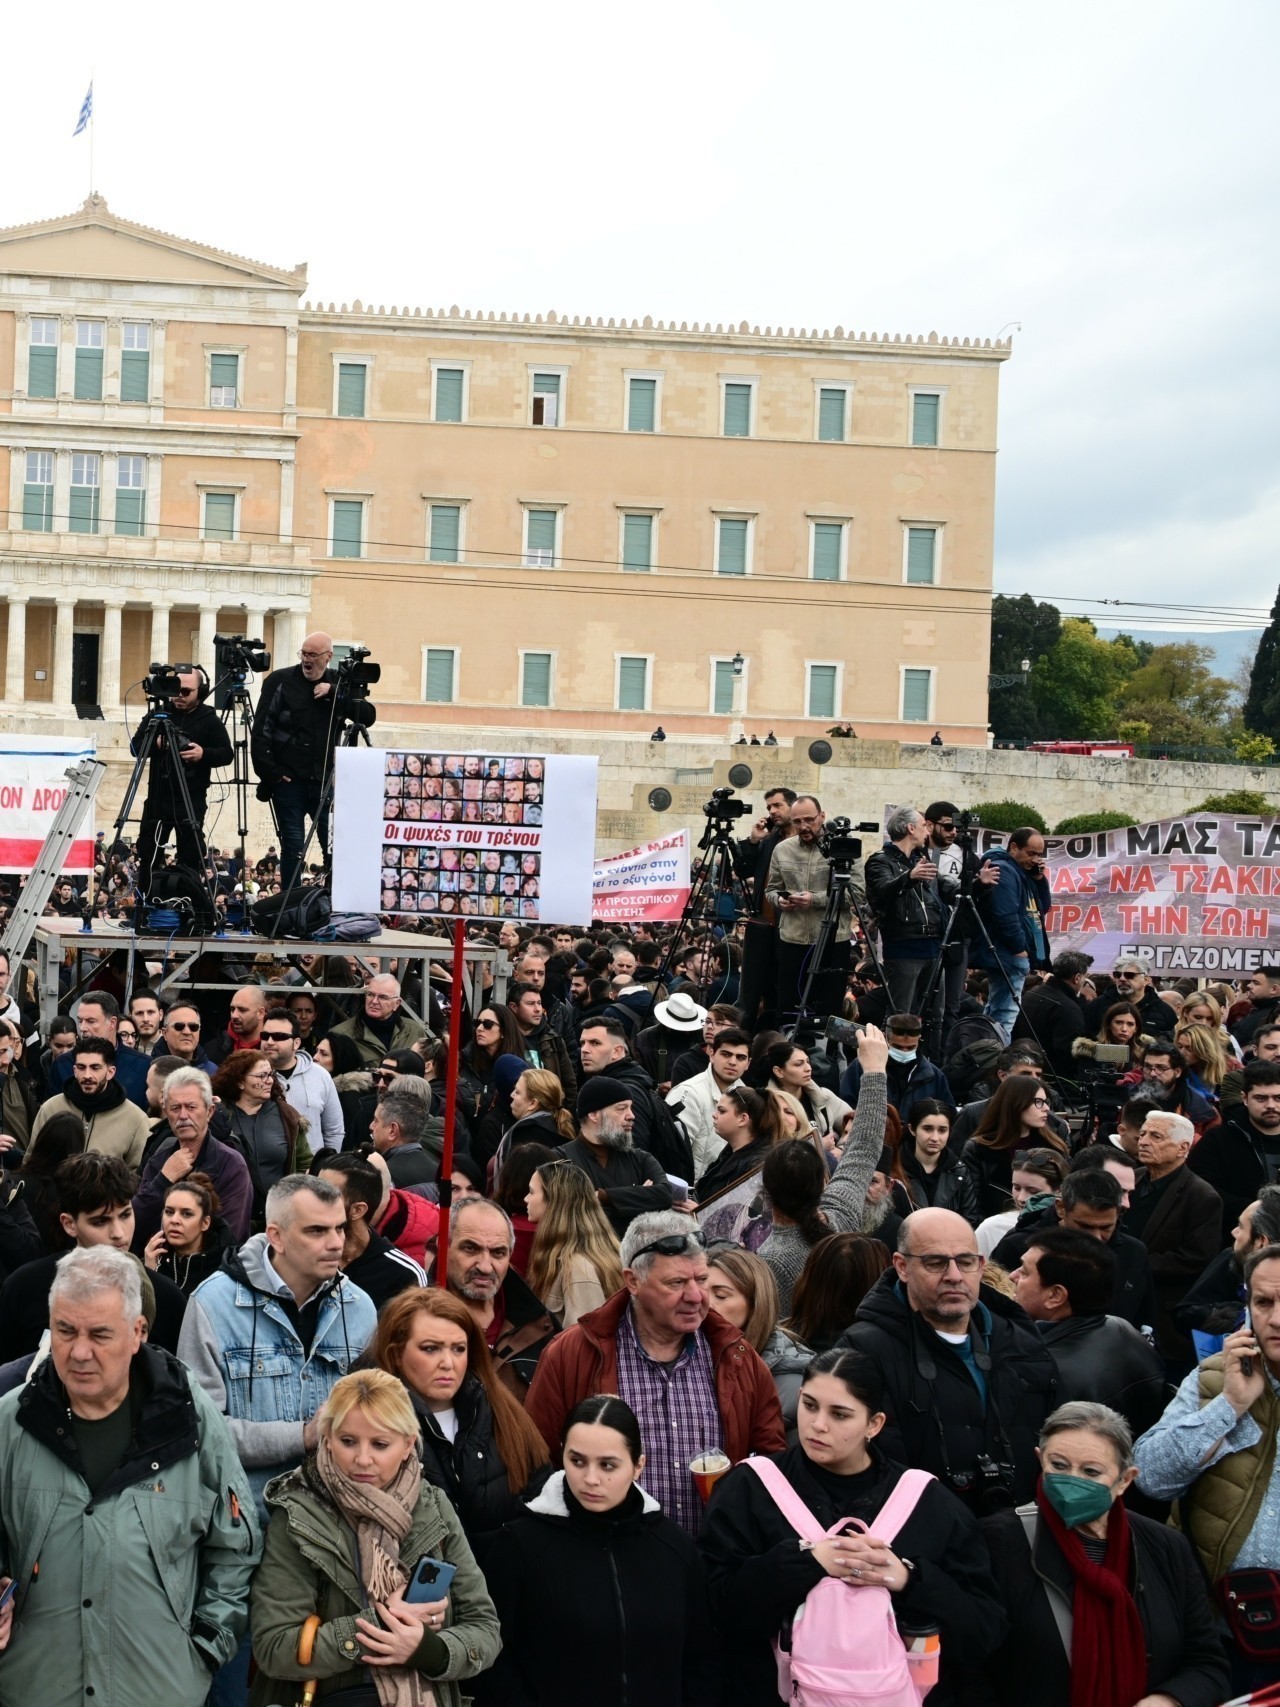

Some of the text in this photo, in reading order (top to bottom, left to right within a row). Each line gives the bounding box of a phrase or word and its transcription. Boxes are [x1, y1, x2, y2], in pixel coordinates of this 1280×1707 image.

[32, 788, 67, 811] ΔΡΟ
[384, 823, 540, 847] Οι ψυχές του τρένου
[647, 835, 684, 852] ΜΑΣ!
[1126, 821, 1219, 857] ΜΑΣ
[607, 863, 648, 875] ενάντια
[650, 860, 678, 868] στην
[1044, 866, 1097, 894] ΑΣ
[1109, 864, 1157, 894] ΝΑ
[608, 879, 619, 887] το
[622, 872, 676, 886] οξυγόνο!
[605, 894, 679, 906] ΠΡΟΣΩΠΙΚΟΥ
[1117, 904, 1189, 936] ΤΗΝ
[1201, 906, 1270, 939] ΖΩΗ
